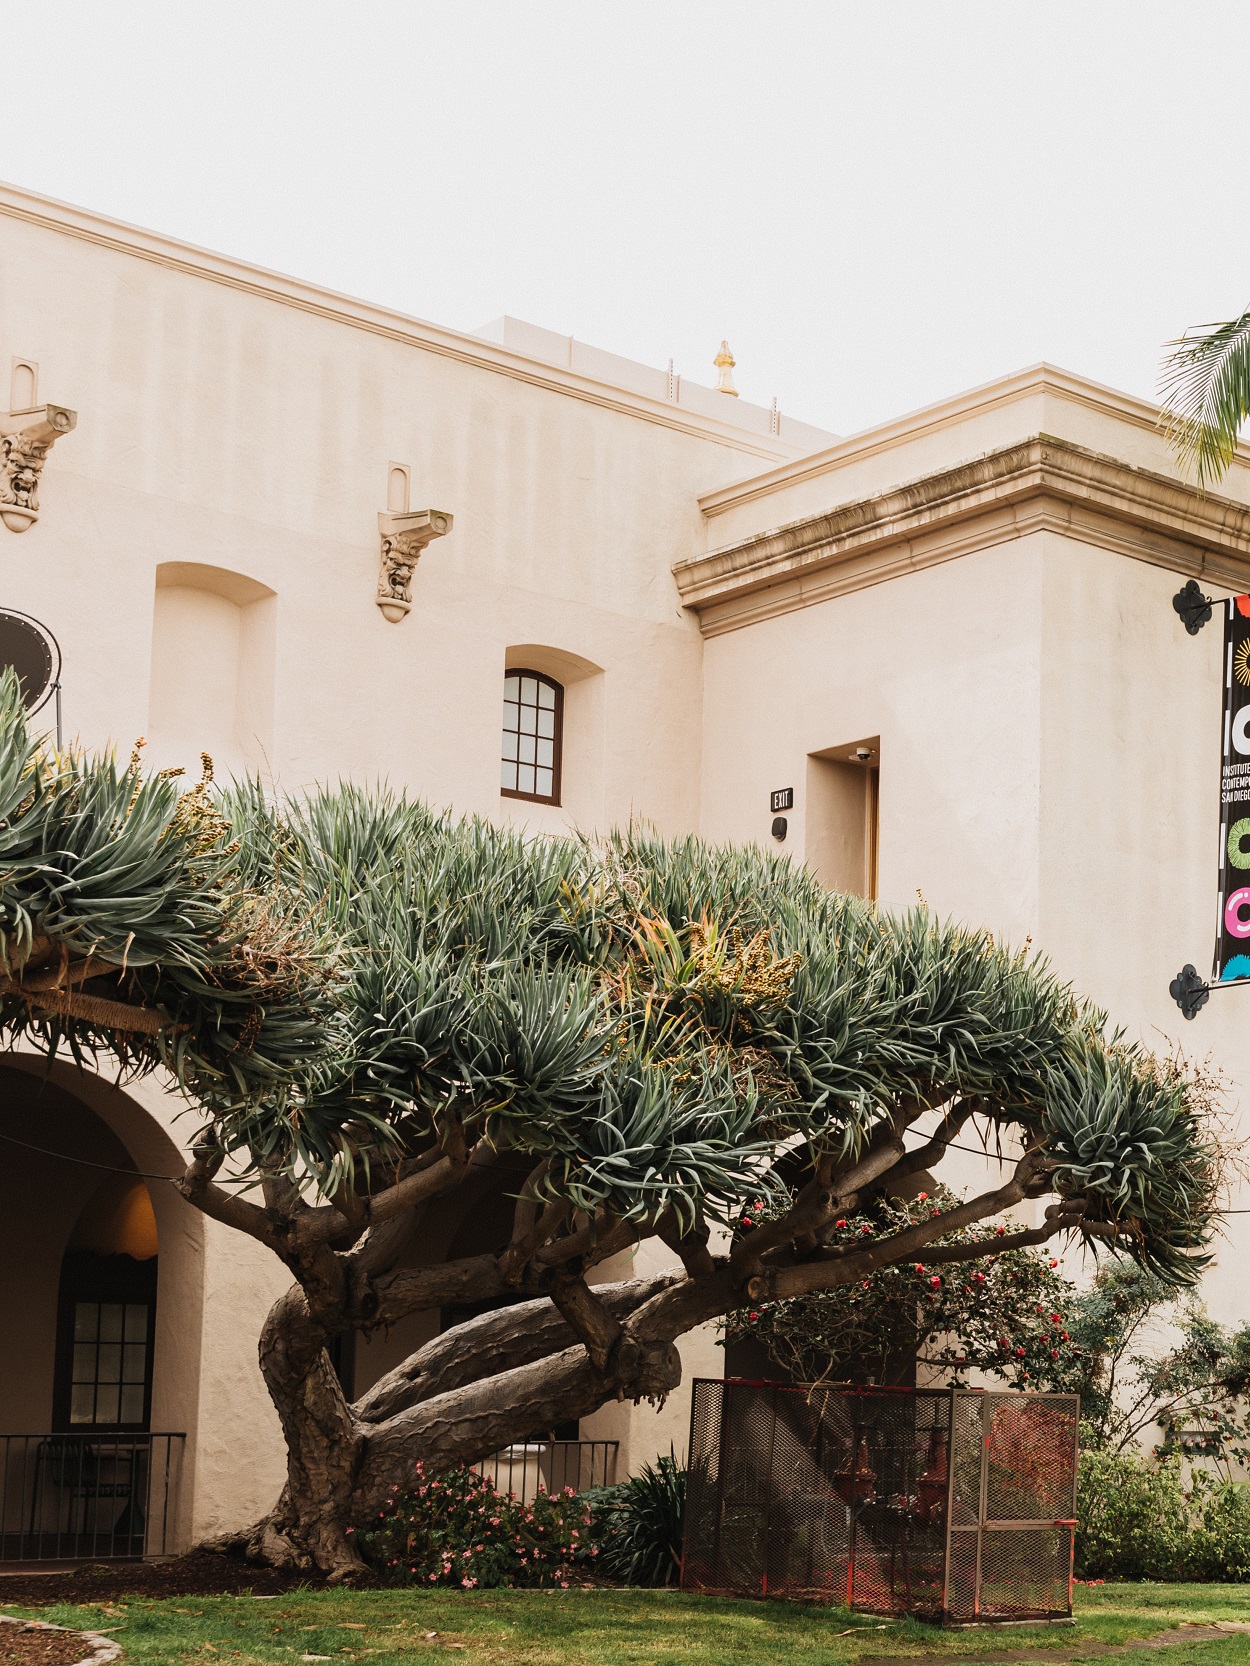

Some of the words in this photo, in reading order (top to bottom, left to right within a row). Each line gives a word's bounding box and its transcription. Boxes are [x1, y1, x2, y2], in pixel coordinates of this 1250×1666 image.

[1223, 762, 1250, 777] INSTITUTE
[774, 791, 788, 809] EXIT
[1221, 790, 1234, 803] SAN
